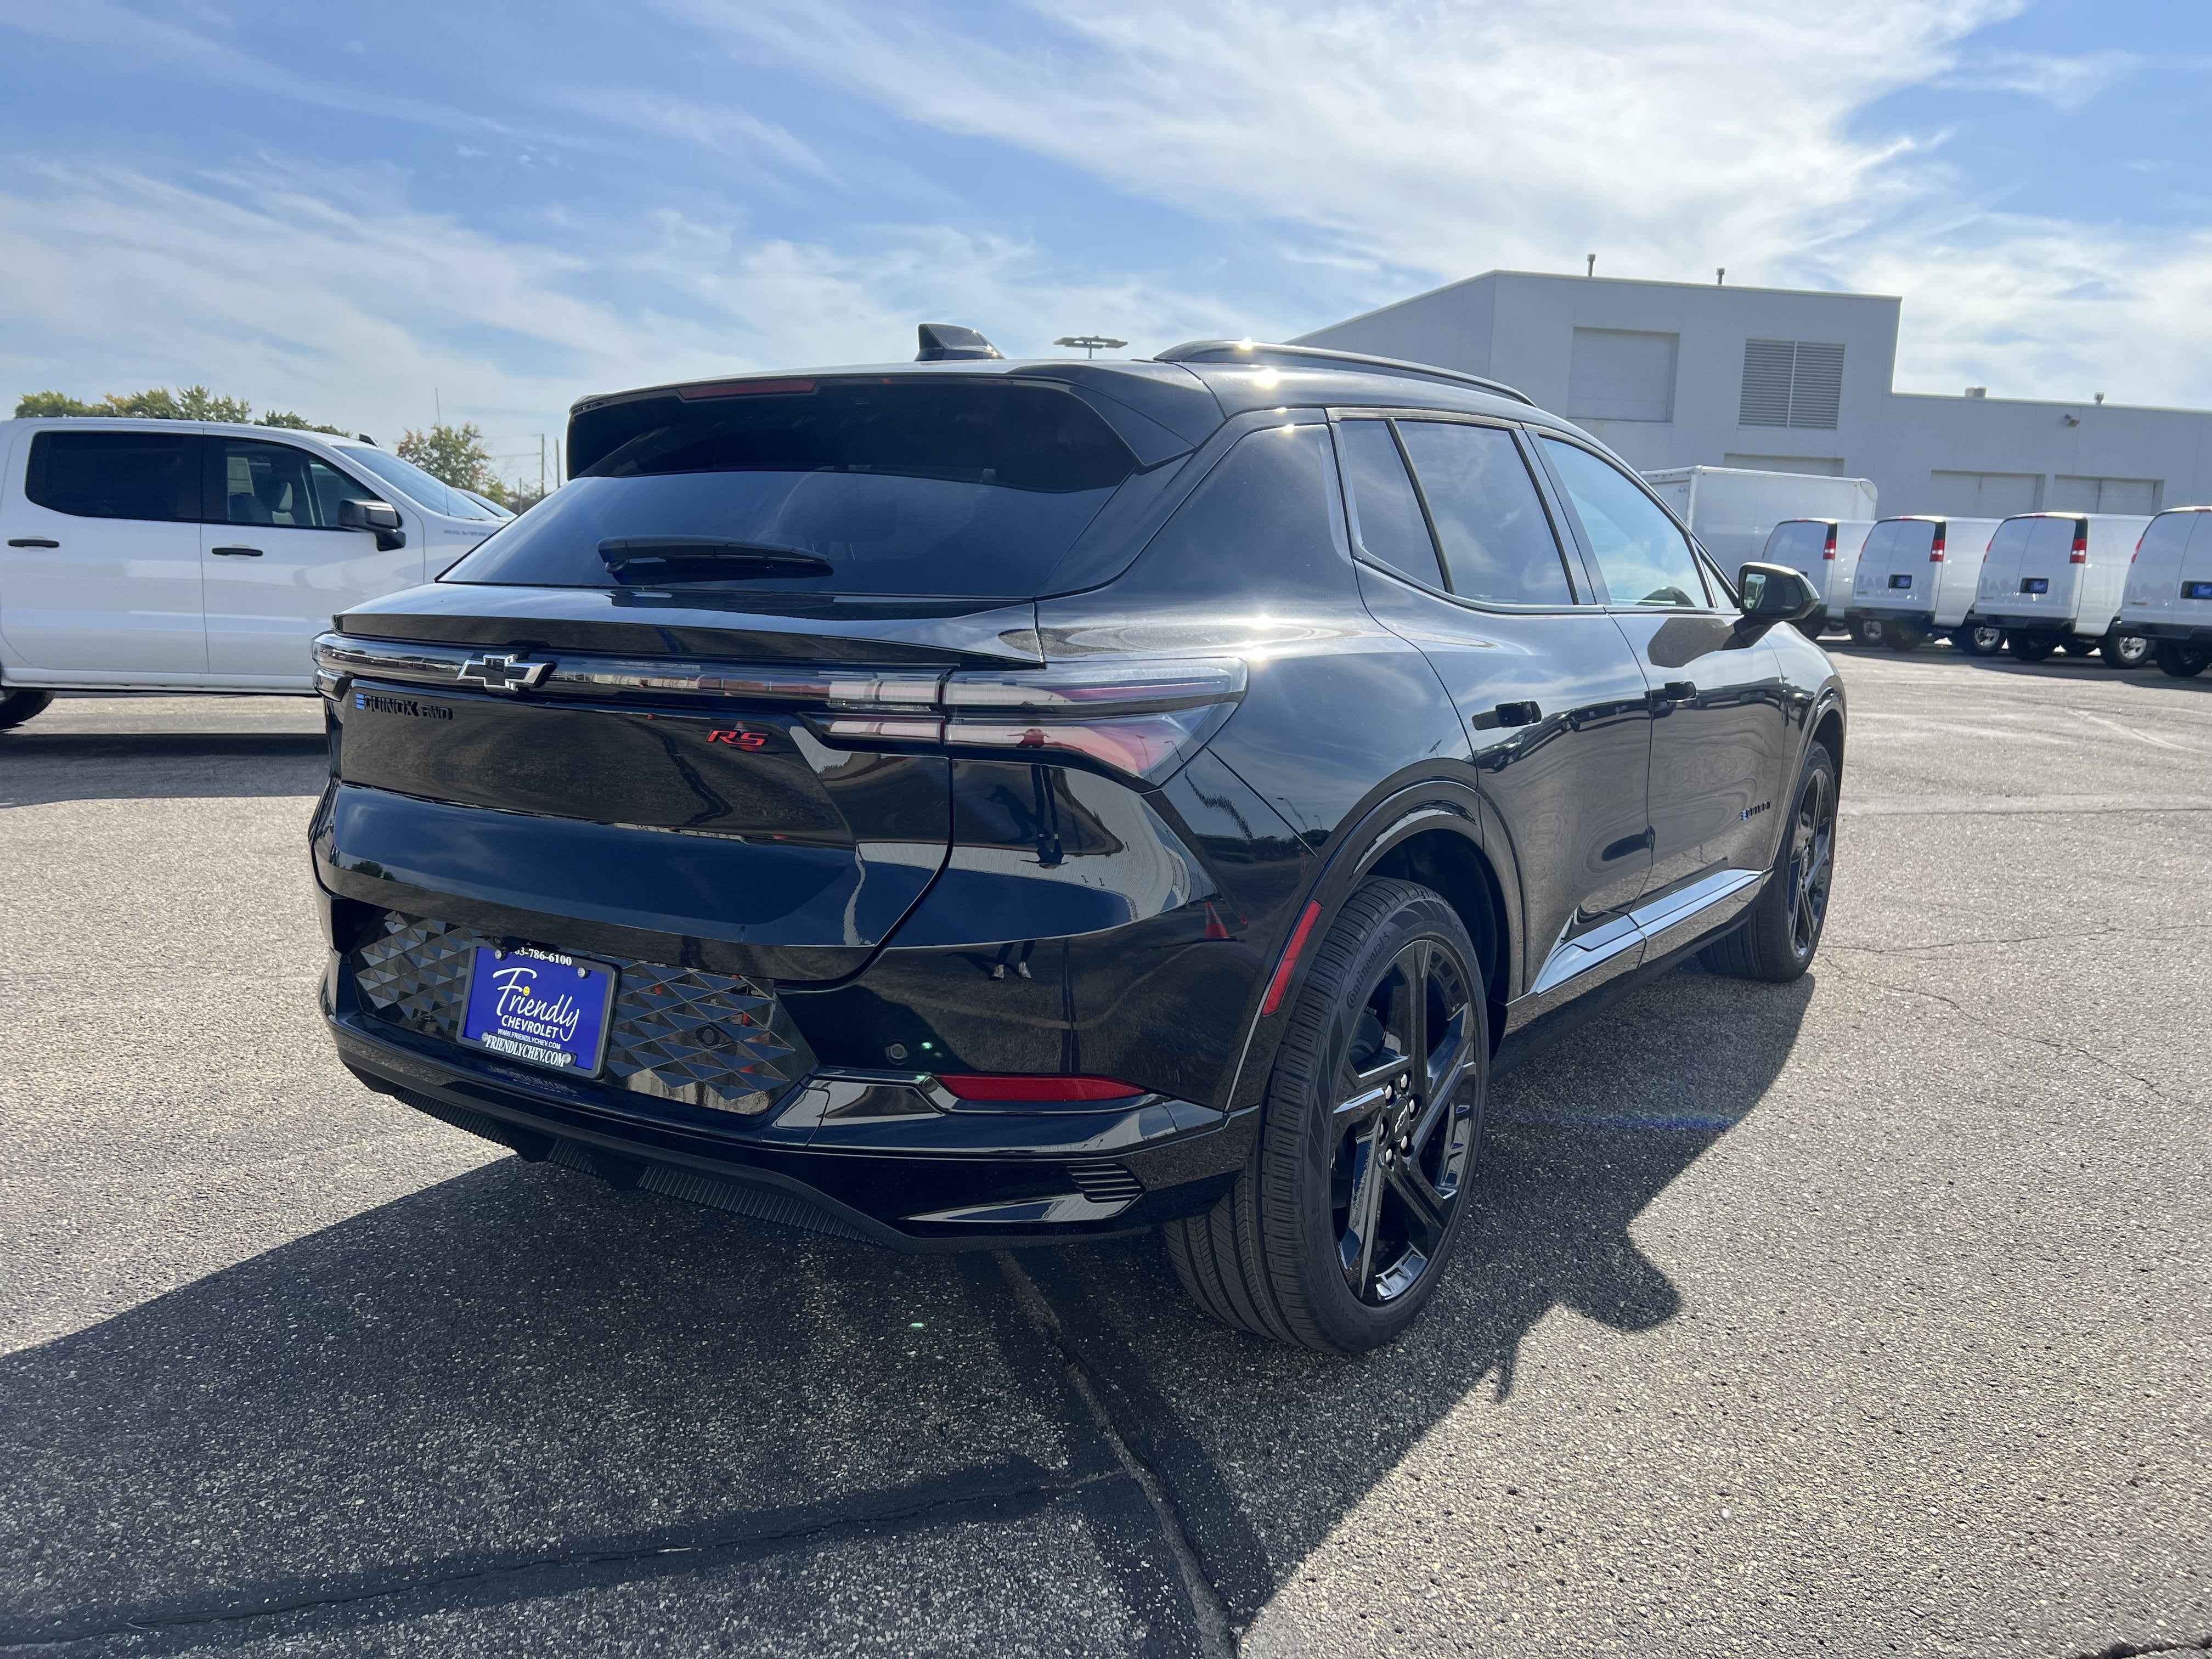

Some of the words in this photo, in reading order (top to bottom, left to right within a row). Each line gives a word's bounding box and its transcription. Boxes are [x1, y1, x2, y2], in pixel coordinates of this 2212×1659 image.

[707, 729, 770, 747] RS
[1346, 936, 1385, 1010] Continental
[492, 967, 580, 1042] Friendly
[497, 1028, 561, 1050] WWW.FRIENDLYCHEV.COM
[501, 1014, 559, 1039] CHEVROLET
[485, 1035, 566, 1068] FRIENDLYCHEV.COM
